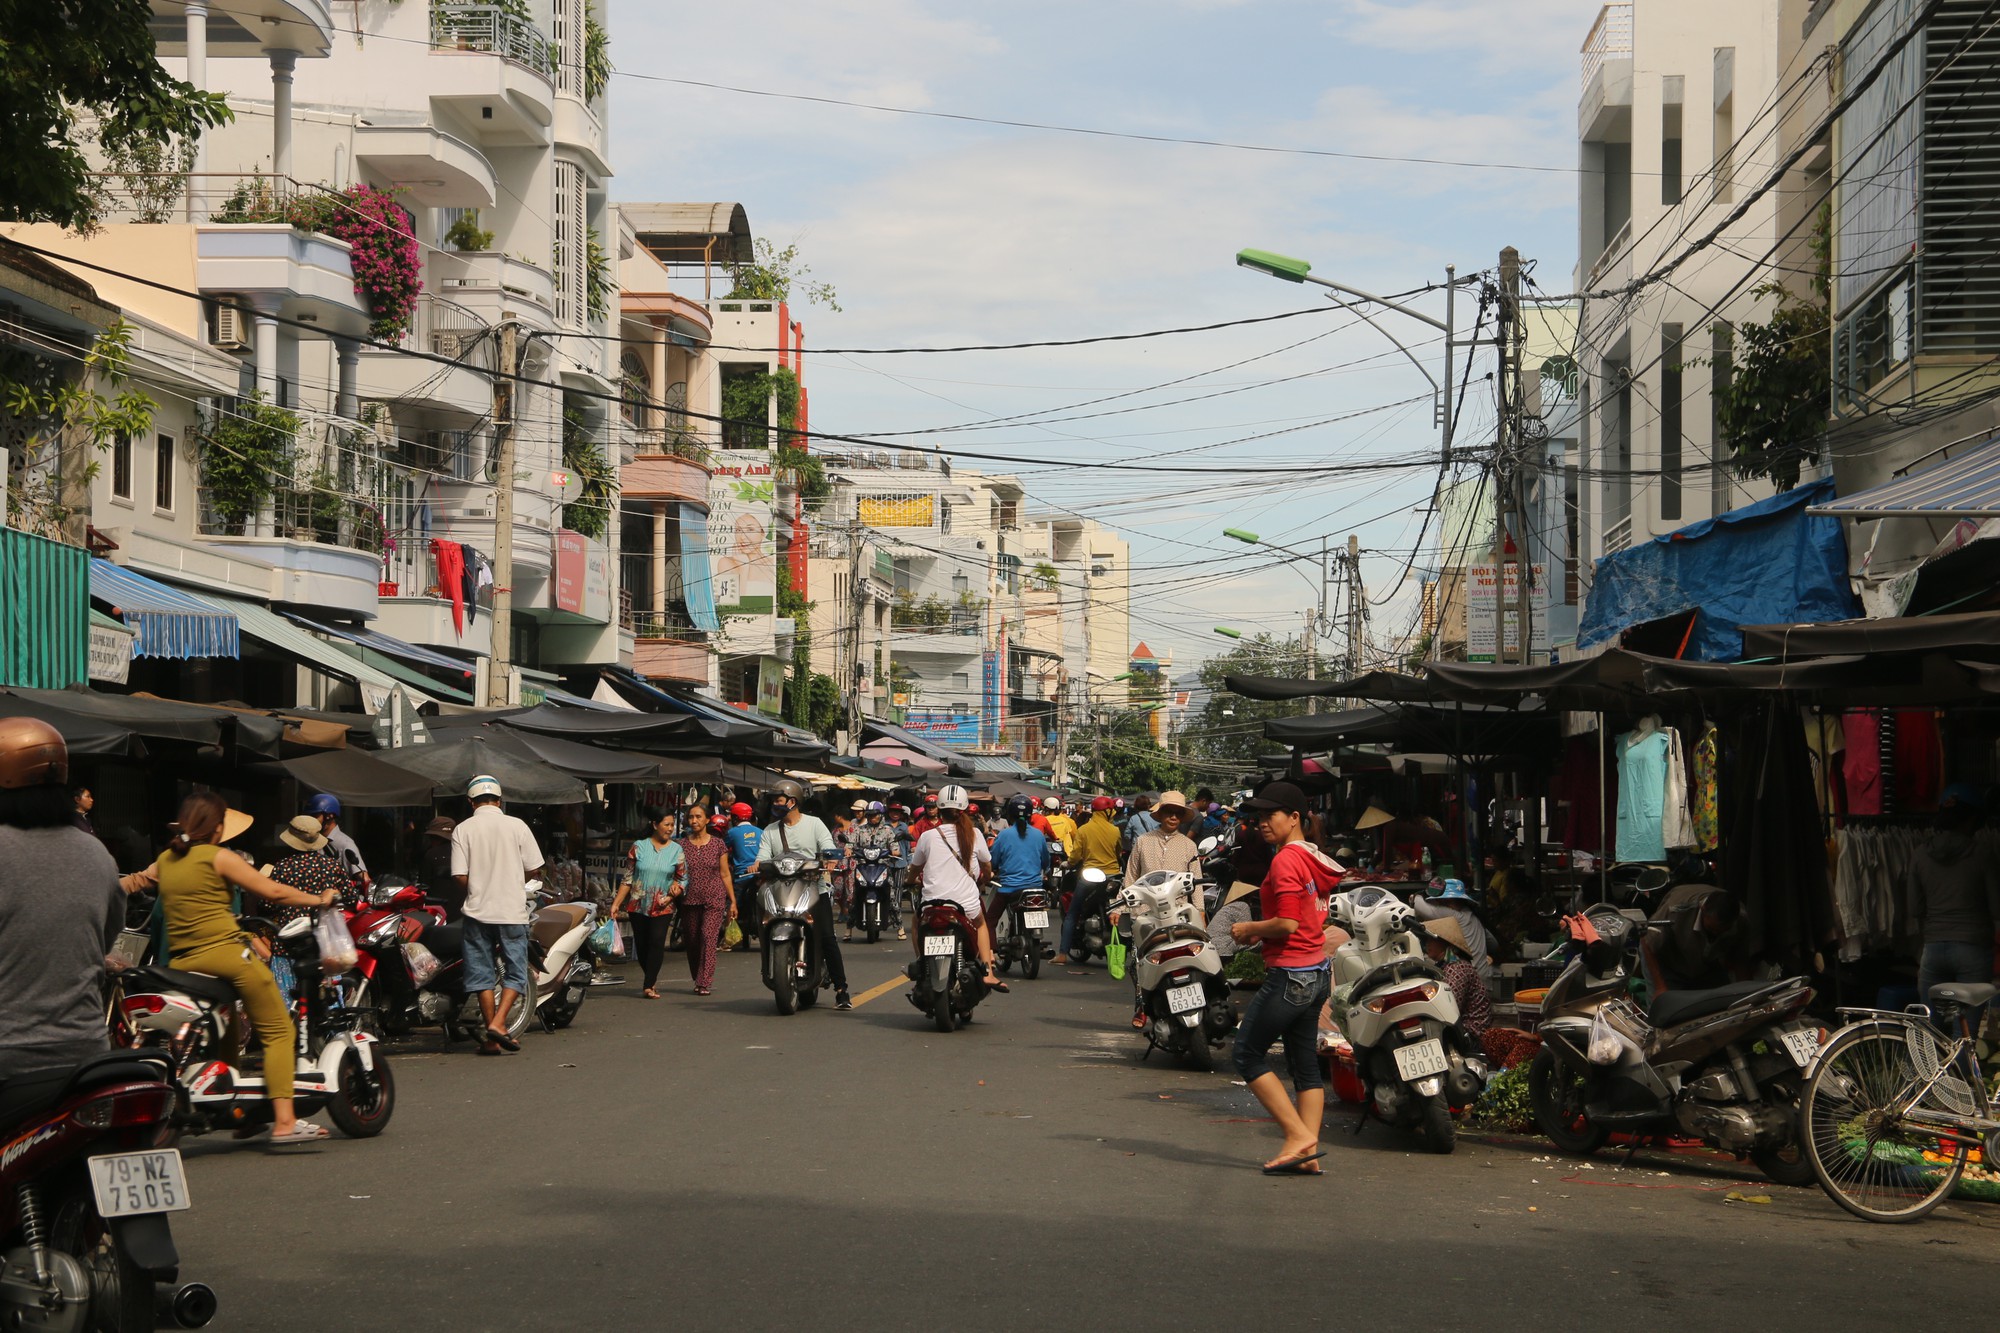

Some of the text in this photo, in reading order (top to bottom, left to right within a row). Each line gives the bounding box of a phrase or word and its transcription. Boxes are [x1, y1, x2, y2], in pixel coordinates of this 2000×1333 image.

[744, 464, 771, 475] Anh
[555, 474, 569, 484] K+
[1478, 579, 1497, 587] NHA
[585, 856, 608, 868] BÚN
[927, 945, 953, 954] 177.77
[1172, 985, 1197, 1000] 29-D1
[1171, 996, 1203, 1012] 663.45
[1401, 1043, 1434, 1063] 79-D1
[1403, 1056, 1444, 1078] 190.18
[125, 1083, 156, 1091] HONDA
[104, 1155, 170, 1184] 79-N2
[110, 1182, 175, 1213] 7505
